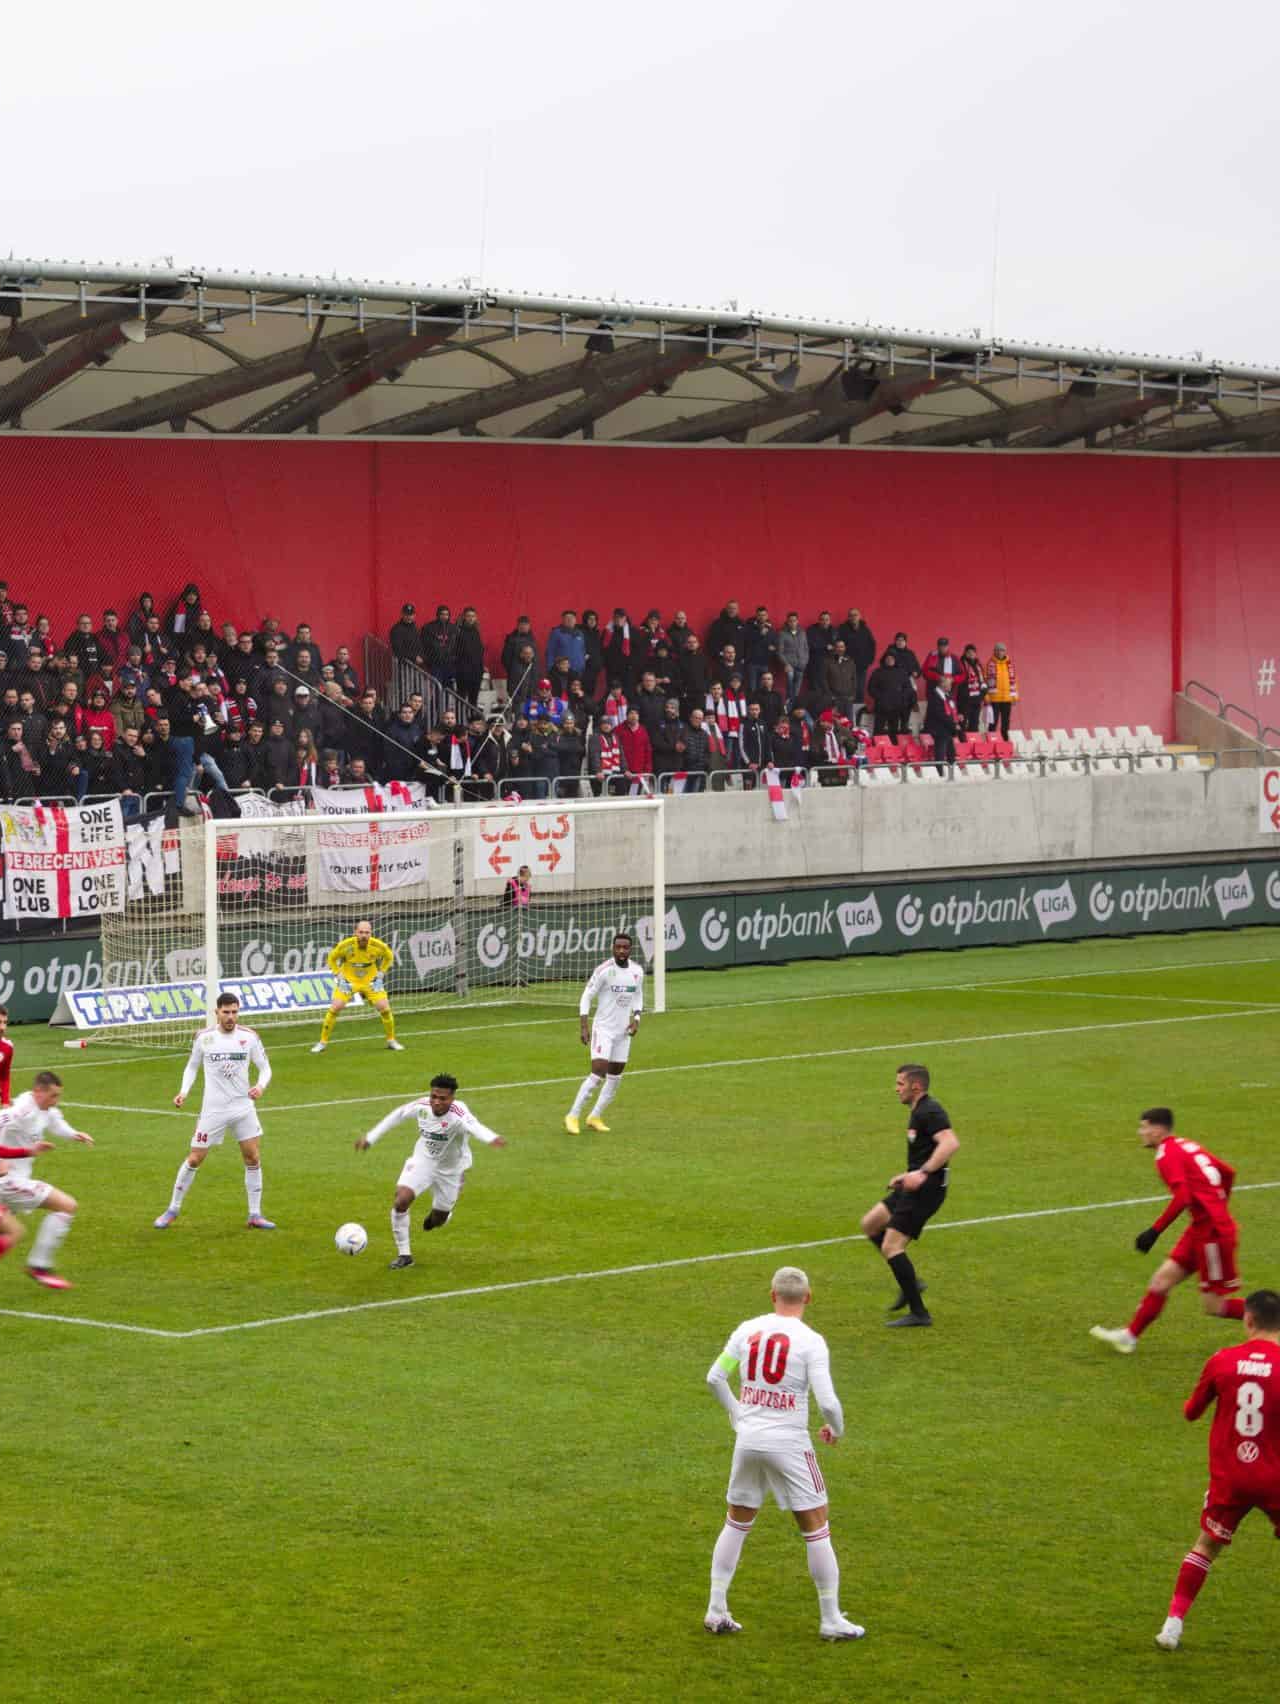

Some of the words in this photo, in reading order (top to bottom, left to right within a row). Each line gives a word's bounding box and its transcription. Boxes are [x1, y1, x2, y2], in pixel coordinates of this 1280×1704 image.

[80, 807, 112, 824] ONE
[81, 825, 113, 843] LIFE
[13, 877, 46, 894] ONE
[82, 873, 115, 892] ONE
[1120, 874, 1212, 922] otpbank
[1222, 884, 1249, 900] LIGA
[79, 891, 119, 911] LOVE
[930, 887, 1032, 936] otpbank
[1041, 895, 1070, 913] LIGA
[645, 924, 678, 942] LA
[736, 899, 836, 950] otpbank
[844, 909, 875, 927] LIGA
[419, 938, 454, 959] LIGA
[24, 947, 159, 994] otpbank
[747, 1331, 791, 1385] 10
[1235, 1381, 1264, 1438] 8
